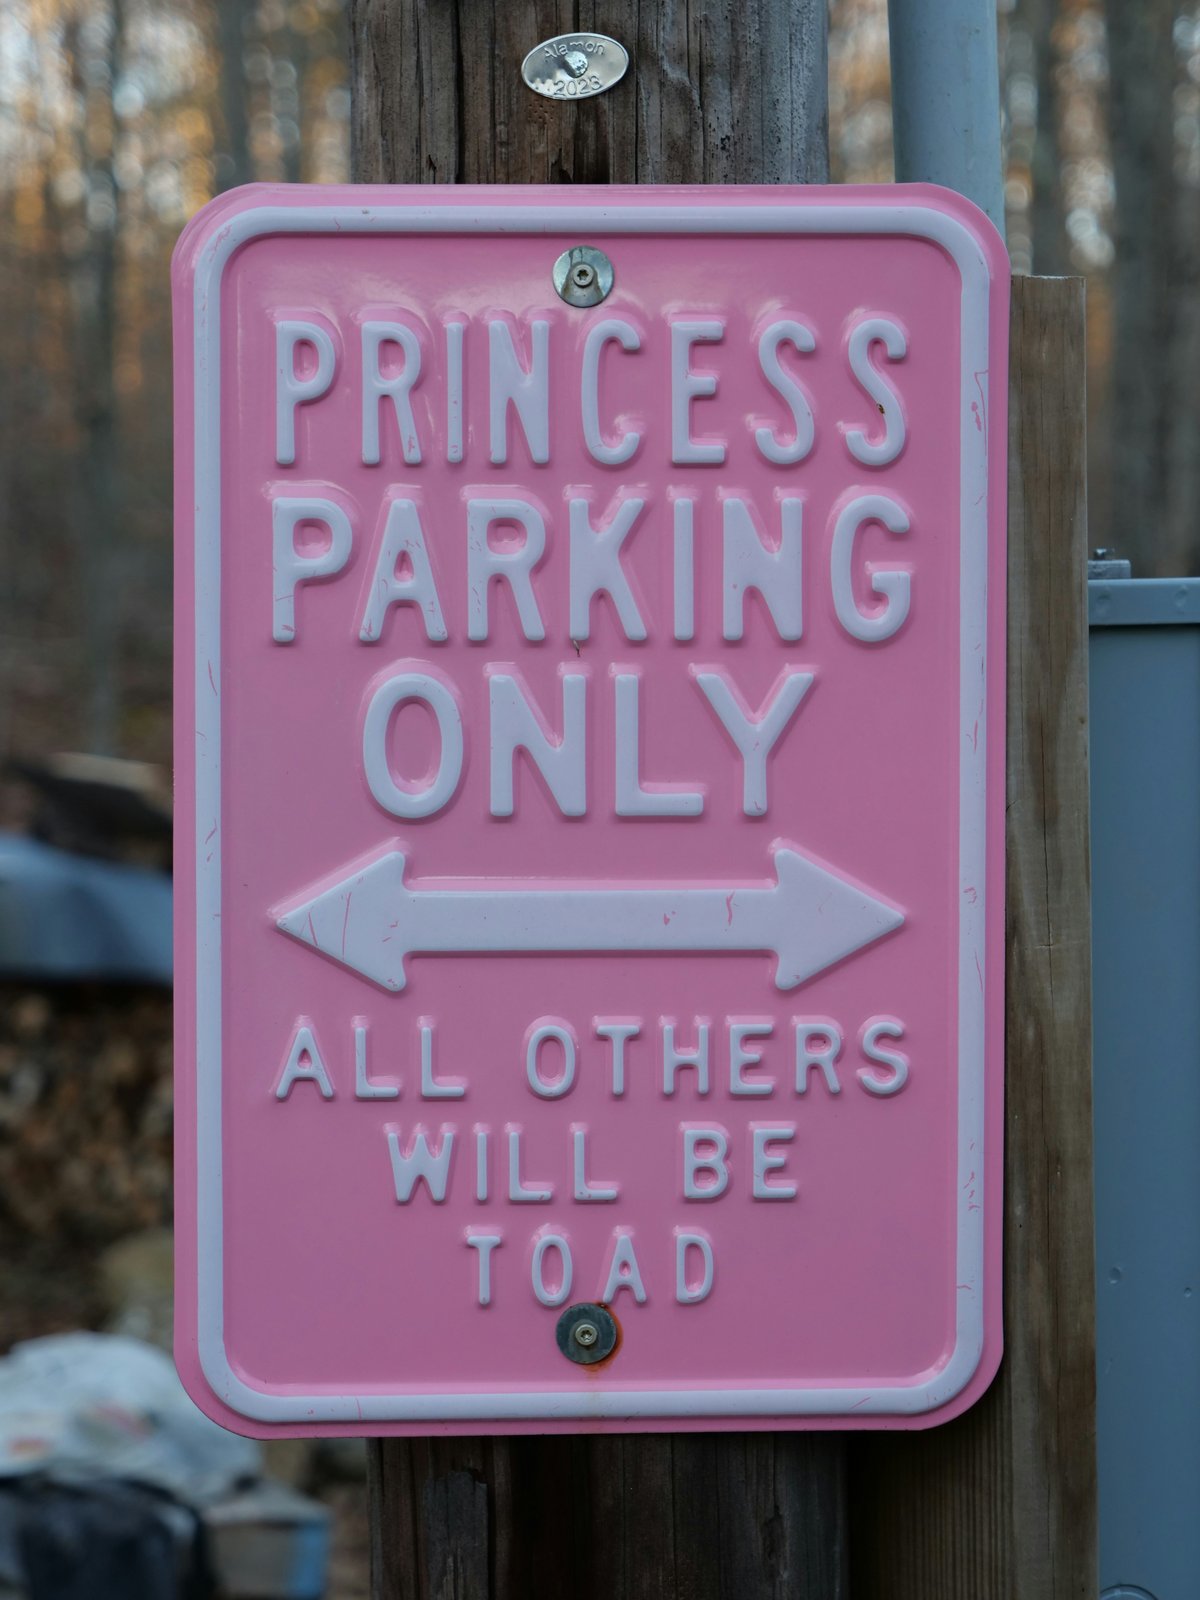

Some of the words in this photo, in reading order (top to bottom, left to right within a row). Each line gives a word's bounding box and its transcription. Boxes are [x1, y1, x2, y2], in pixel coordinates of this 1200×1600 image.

[544, 40, 605, 58] Alamon
[553, 75, 602, 96] 2023
[274, 318, 908, 467] PRINCESS
[271, 494, 912, 643] PARKING
[363, 672, 816, 818] ONLY
[275, 1025, 468, 1099] ALL
[524, 1021, 910, 1098] OTHERS
[386, 1128, 620, 1202] WILL
[684, 1127, 798, 1201] BE
[466, 1232, 716, 1306] TOAD
